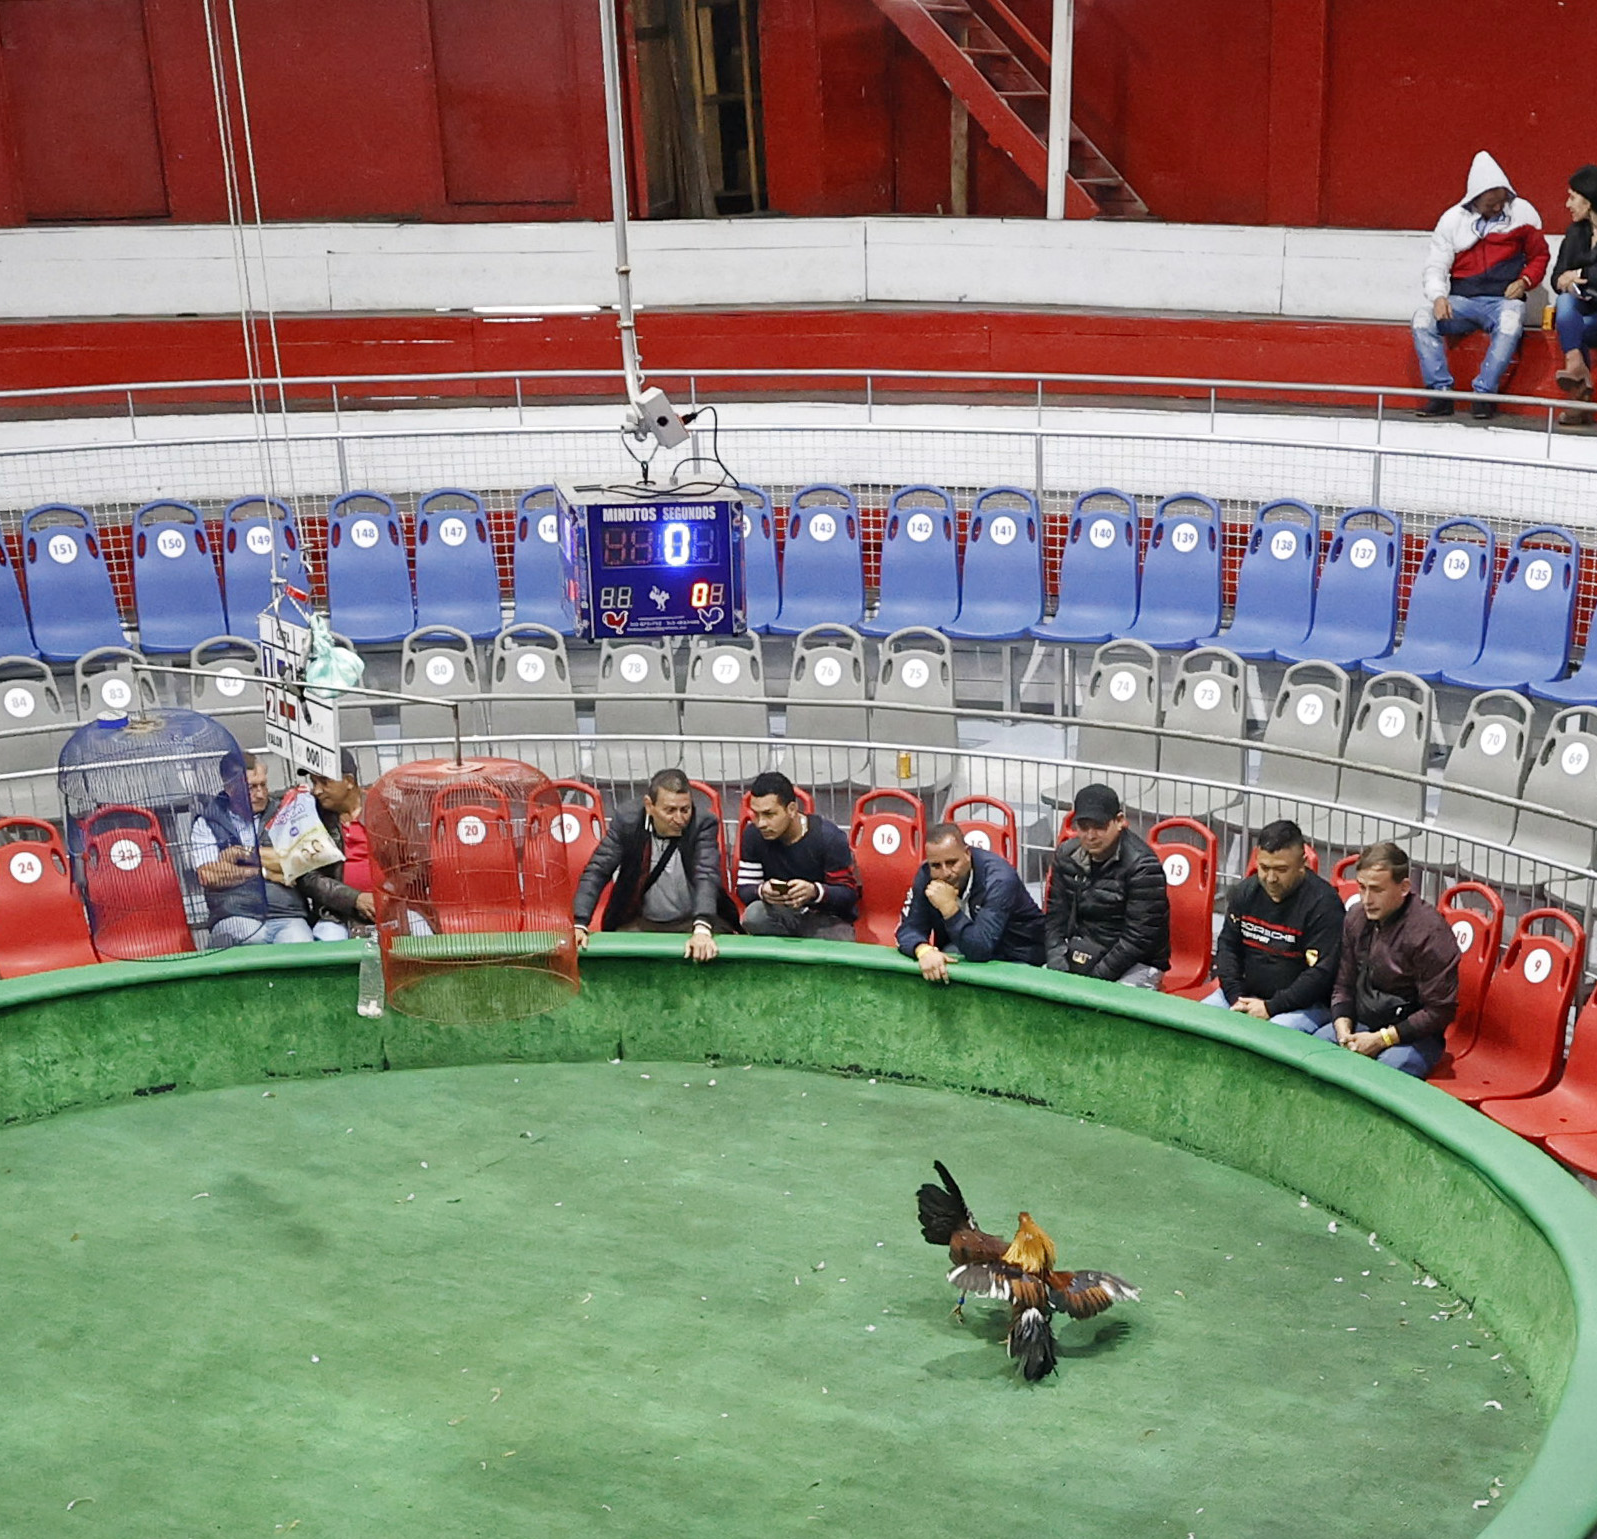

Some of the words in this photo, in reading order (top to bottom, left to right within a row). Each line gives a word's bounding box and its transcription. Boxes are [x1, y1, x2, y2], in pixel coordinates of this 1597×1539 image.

[602, 507, 657, 522] MINUTOS
[662, 505, 716, 521] SEGUNDOS
[355, 528, 376, 539] 148
[444, 526, 463, 537] 147
[814, 522, 832, 533] 143
[912, 522, 930, 533] 142
[995, 525, 1012, 536] 141
[1094, 527, 1112, 540] 140
[162, 538, 182, 550] 150
[251, 535, 271, 546] 149
[1177, 531, 1195, 544] 139
[53, 543, 73, 555] 151
[1275, 539, 1294, 552] 138
[1354, 547, 1374, 560] 137
[1448, 558, 1466, 571] 136
[1529, 567, 1549, 582] 135
[433, 664, 448, 676] 80
[524, 662, 539, 674] 79
[628, 662, 642, 674] 78
[719, 663, 733, 675] 77
[821, 665, 834, 677] 76
[909, 667, 922, 680] 75
[1116, 680, 1130, 692] 74
[108, 687, 125, 700] 83
[1201, 688, 1215, 701] 73
[11, 696, 28, 709] 84
[265, 687, 276, 722] 2
[1303, 702, 1317, 716] 72
[1384, 715, 1398, 729] 71
[1487, 732, 1501, 746] 70
[1568, 752, 1583, 765] 69
[464, 824, 479, 837] 20
[881, 833, 894, 845] 16
[17, 861, 35, 874] 24
[1170, 863, 1183, 877] 13
[1456, 930, 1468, 945] 10
[1534, 959, 1542, 973] 9
